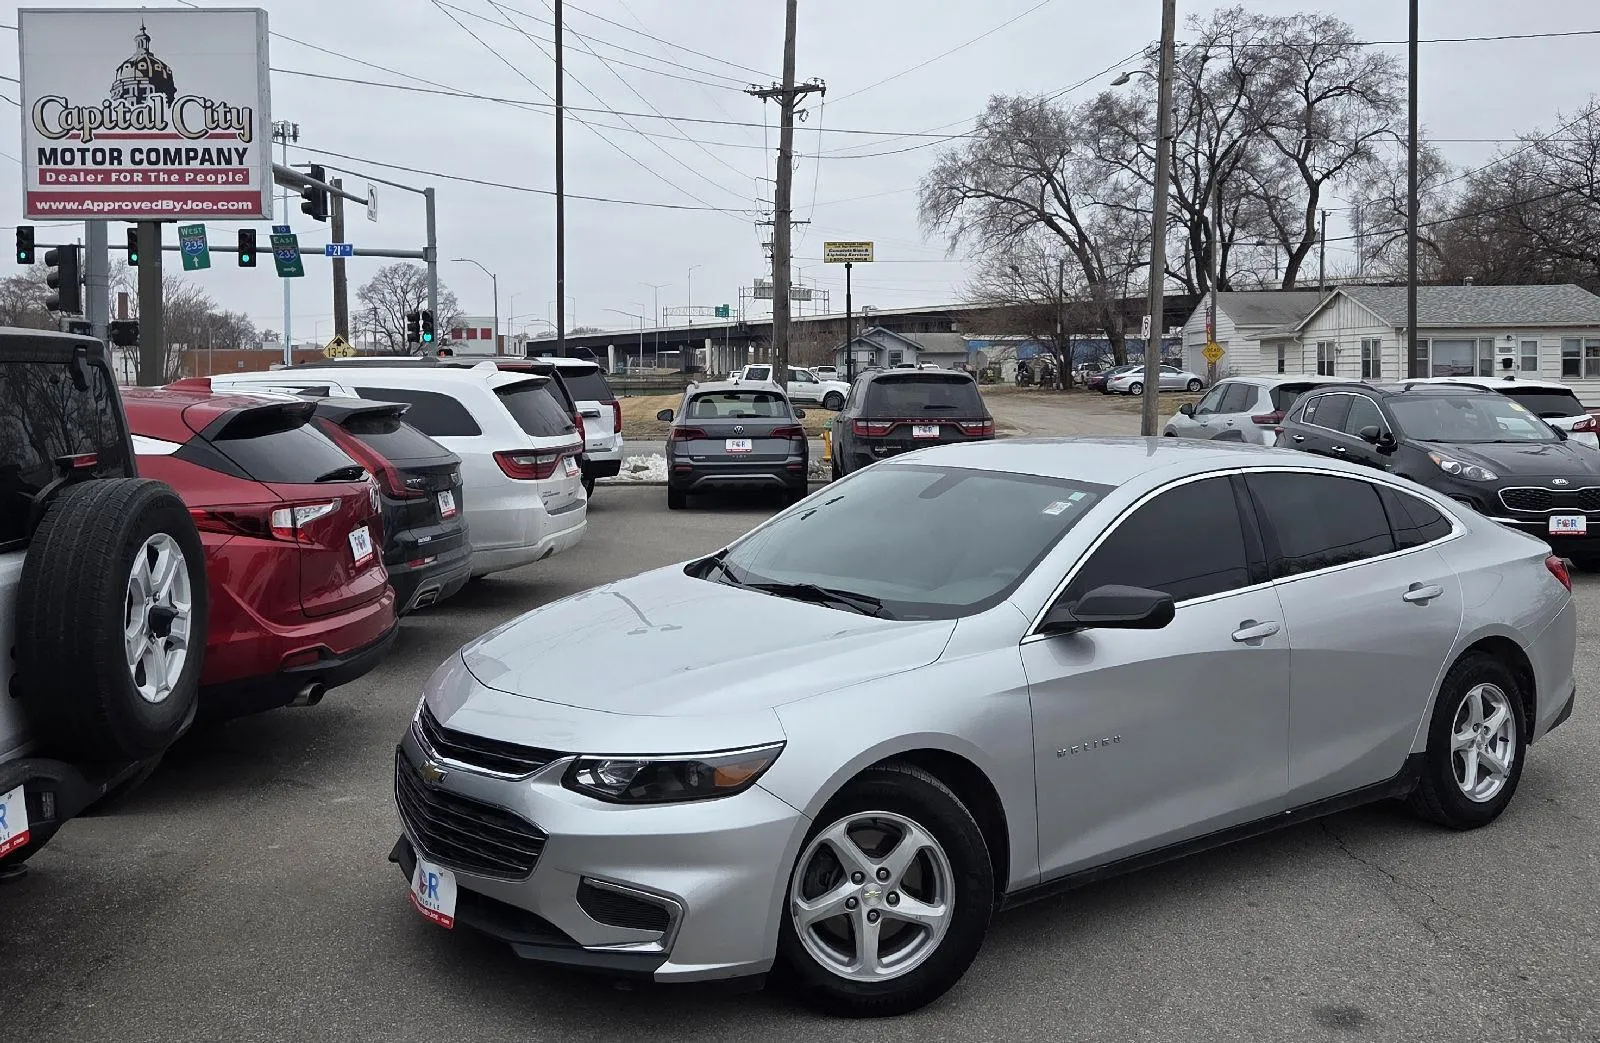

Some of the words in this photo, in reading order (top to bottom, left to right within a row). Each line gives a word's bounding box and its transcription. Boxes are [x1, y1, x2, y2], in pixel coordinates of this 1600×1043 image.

[32, 93, 168, 144] Capital
[172, 94, 253, 144] City
[37, 147, 123, 166] MOTOR
[130, 147, 249, 166] COMPANY
[46, 171, 104, 183] Dealer
[111, 171, 143, 183] FOR
[148, 171, 179, 183] The
[185, 171, 244, 185] People
[35, 199, 253, 212] www.ApprovedByJoe.com
[184, 240, 204, 251] 235
[278, 250, 297, 259] 235
